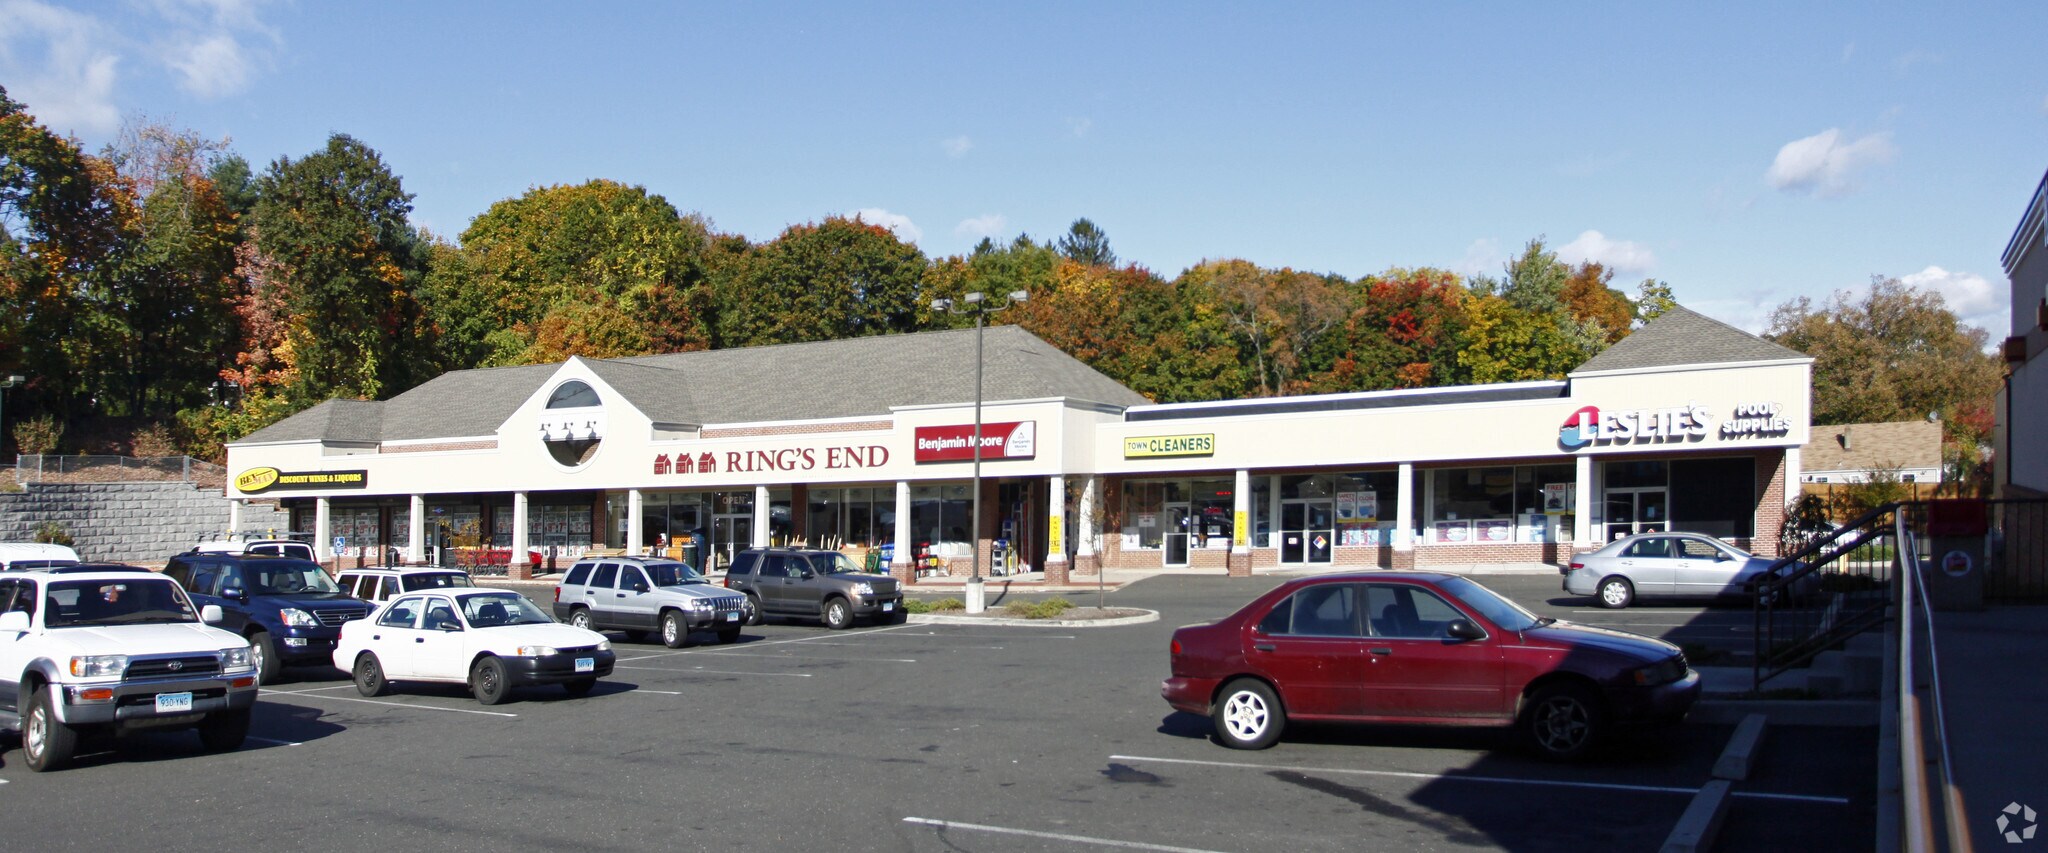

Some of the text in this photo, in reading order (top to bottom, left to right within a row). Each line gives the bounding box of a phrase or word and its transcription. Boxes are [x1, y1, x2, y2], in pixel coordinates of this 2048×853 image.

[1737, 401, 1776, 416] POOL
[1578, 402, 1711, 441] LESLIE'S
[1722, 416, 1792, 433] SUPPLIES
[918, 436, 966, 451] Benjamin
[1127, 437, 1211, 452] TOWN CLEANERS
[725, 445, 889, 473] RING'S END
[279, 473, 362, 484] DISCOUNT WINES & LIQUORS
[722, 495, 745, 505] OPEN
